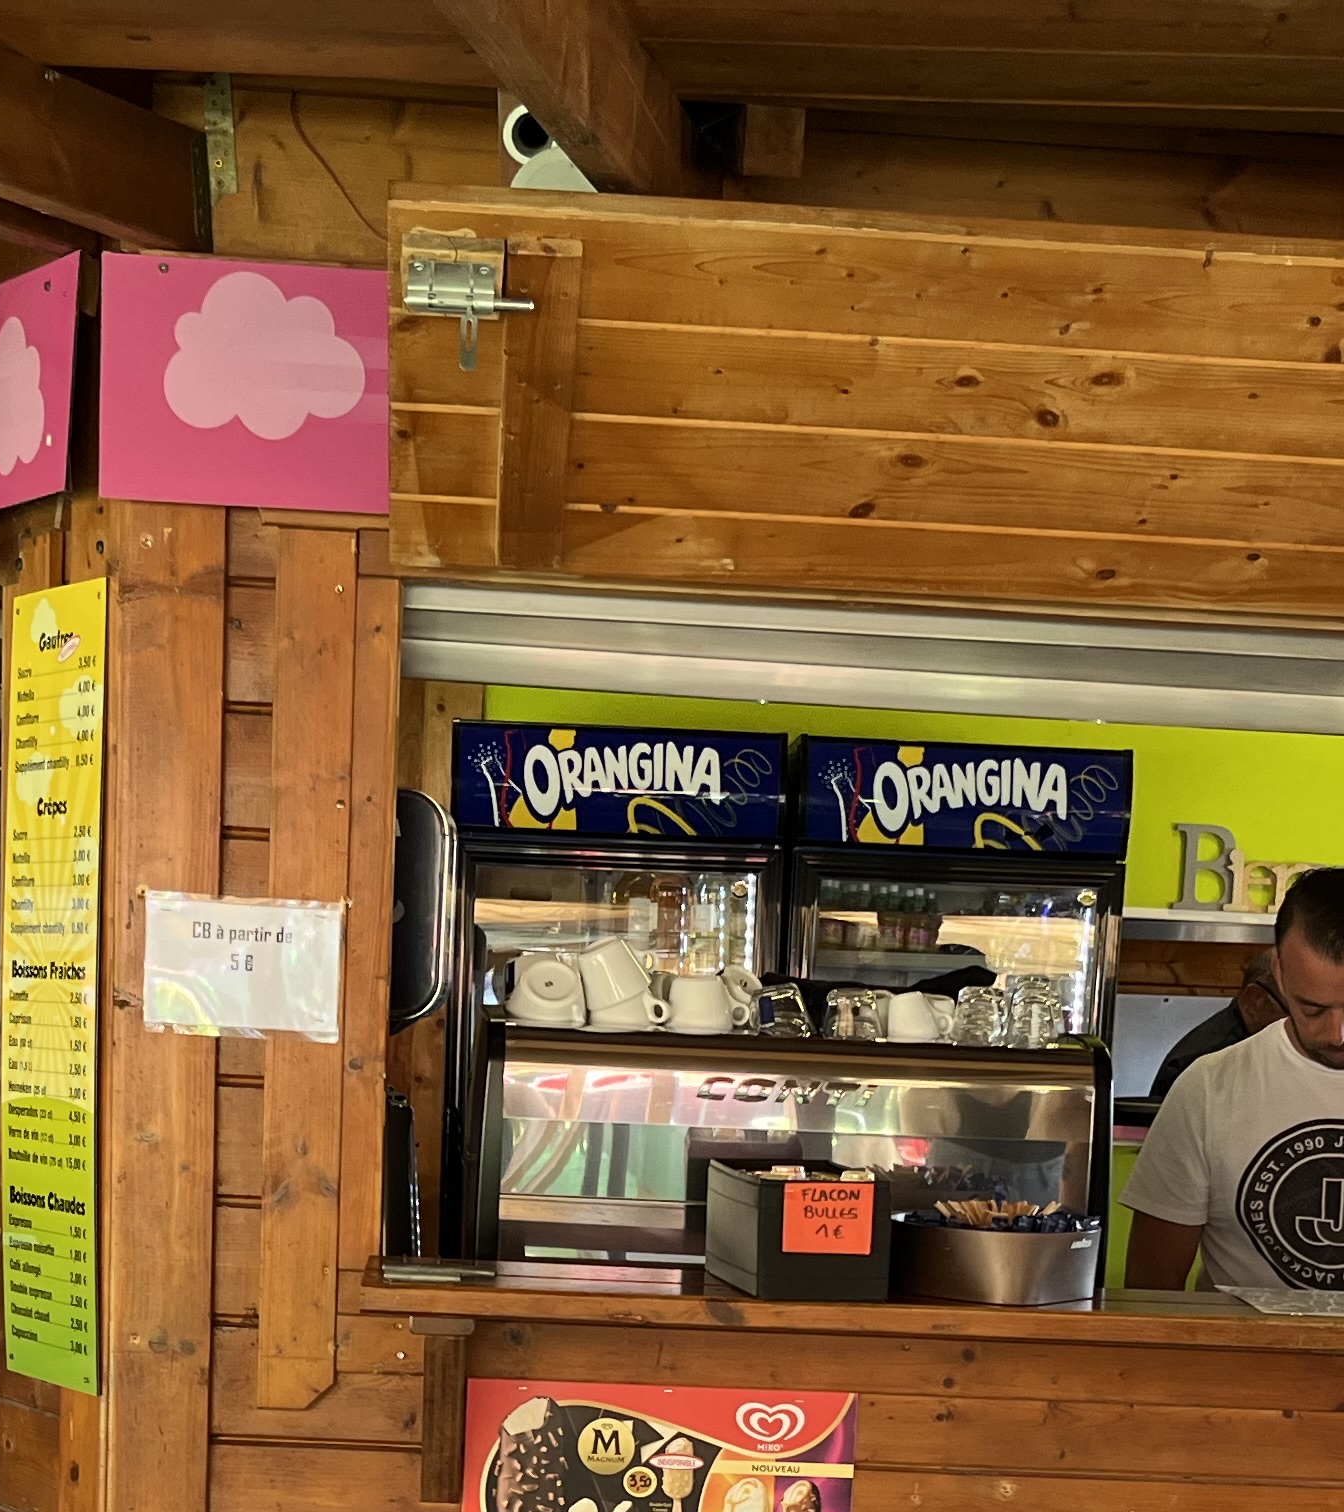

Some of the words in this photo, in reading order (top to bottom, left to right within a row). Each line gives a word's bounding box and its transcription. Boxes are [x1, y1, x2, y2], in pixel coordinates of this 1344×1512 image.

[523, 742, 721, 817] ORANGINA
[872, 758, 1067, 832] ORANGINA
[38, 797, 67, 819] Crêpes
[192, 921, 211, 939] CB
[216, 925, 224, 940] à
[229, 926, 271, 944] partir
[276, 926, 292, 944] de
[12, 960, 48, 979] Boissons
[230, 954, 239, 971] 5
[245, 954, 254, 972] €
[696, 1076, 879, 1107] CONTI
[1284, 1136, 1325, 1159] 1990
[10, 1186, 46, 1208] Boissons
[48, 1192, 86, 1216] Chaudes
[801, 1188, 860, 1202] FLACON
[804, 1205, 858, 1220] BULLES
[591, 1428, 622, 1456] M
[757, 1443, 781, 1452] MIKO
[587, 1454, 627, 1464] MAGNUM
[751, 1464, 800, 1474] NOUVEAU
